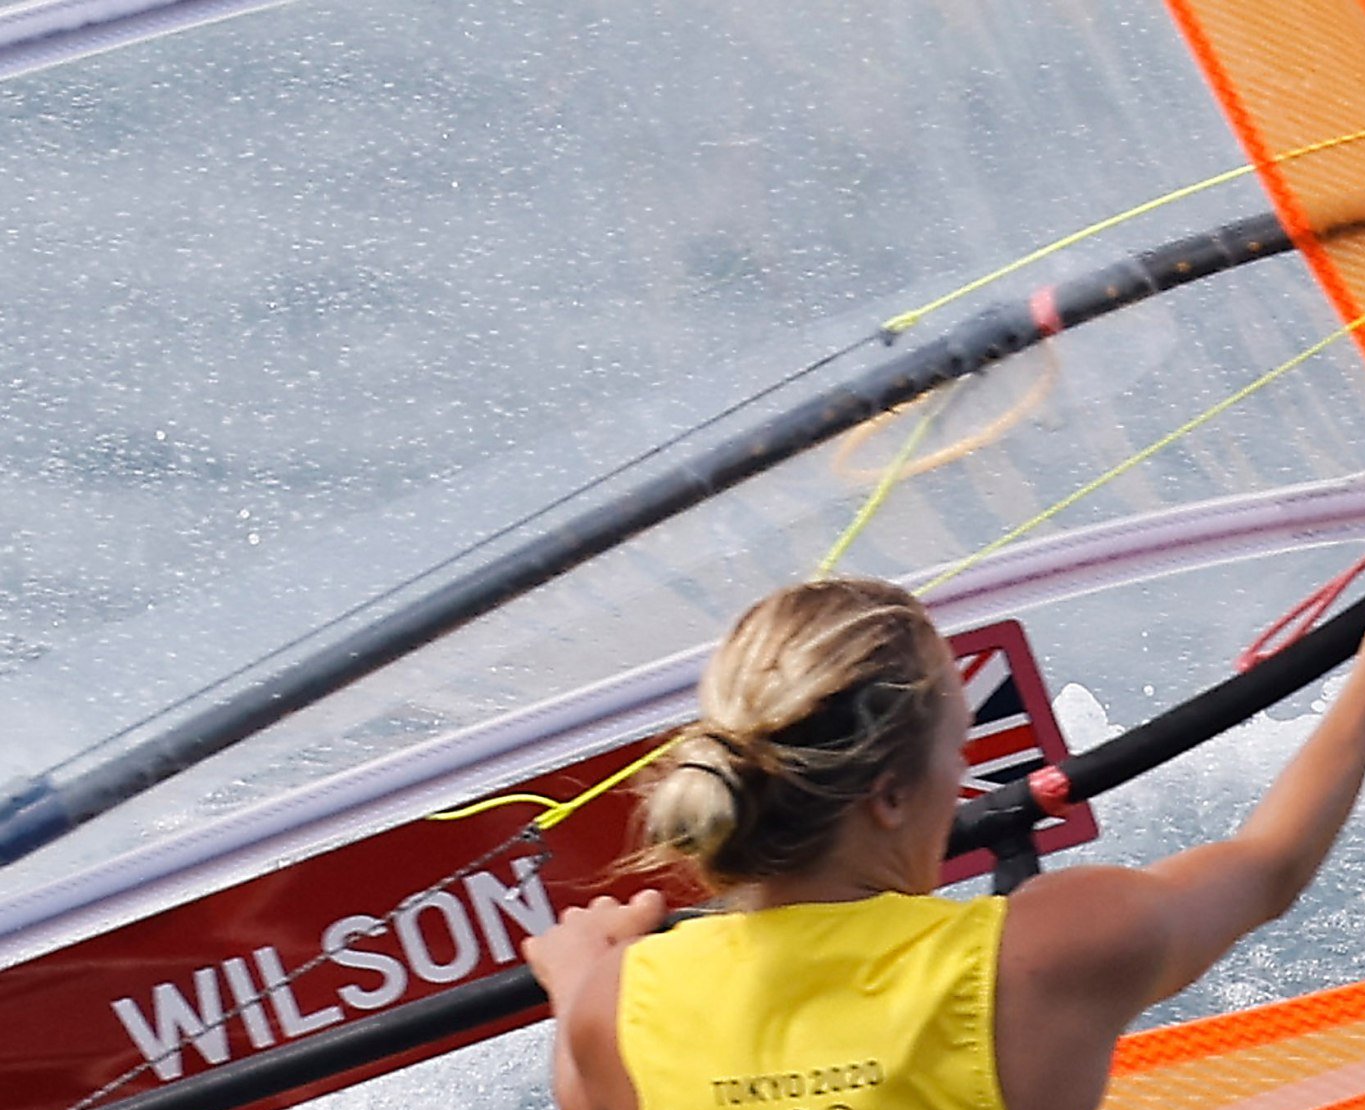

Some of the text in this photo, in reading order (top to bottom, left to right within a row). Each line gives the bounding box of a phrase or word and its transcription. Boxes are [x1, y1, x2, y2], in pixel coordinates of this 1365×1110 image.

[112, 854, 557, 1081] WILSON
[711, 1059, 885, 1106] TOKYO 2020
